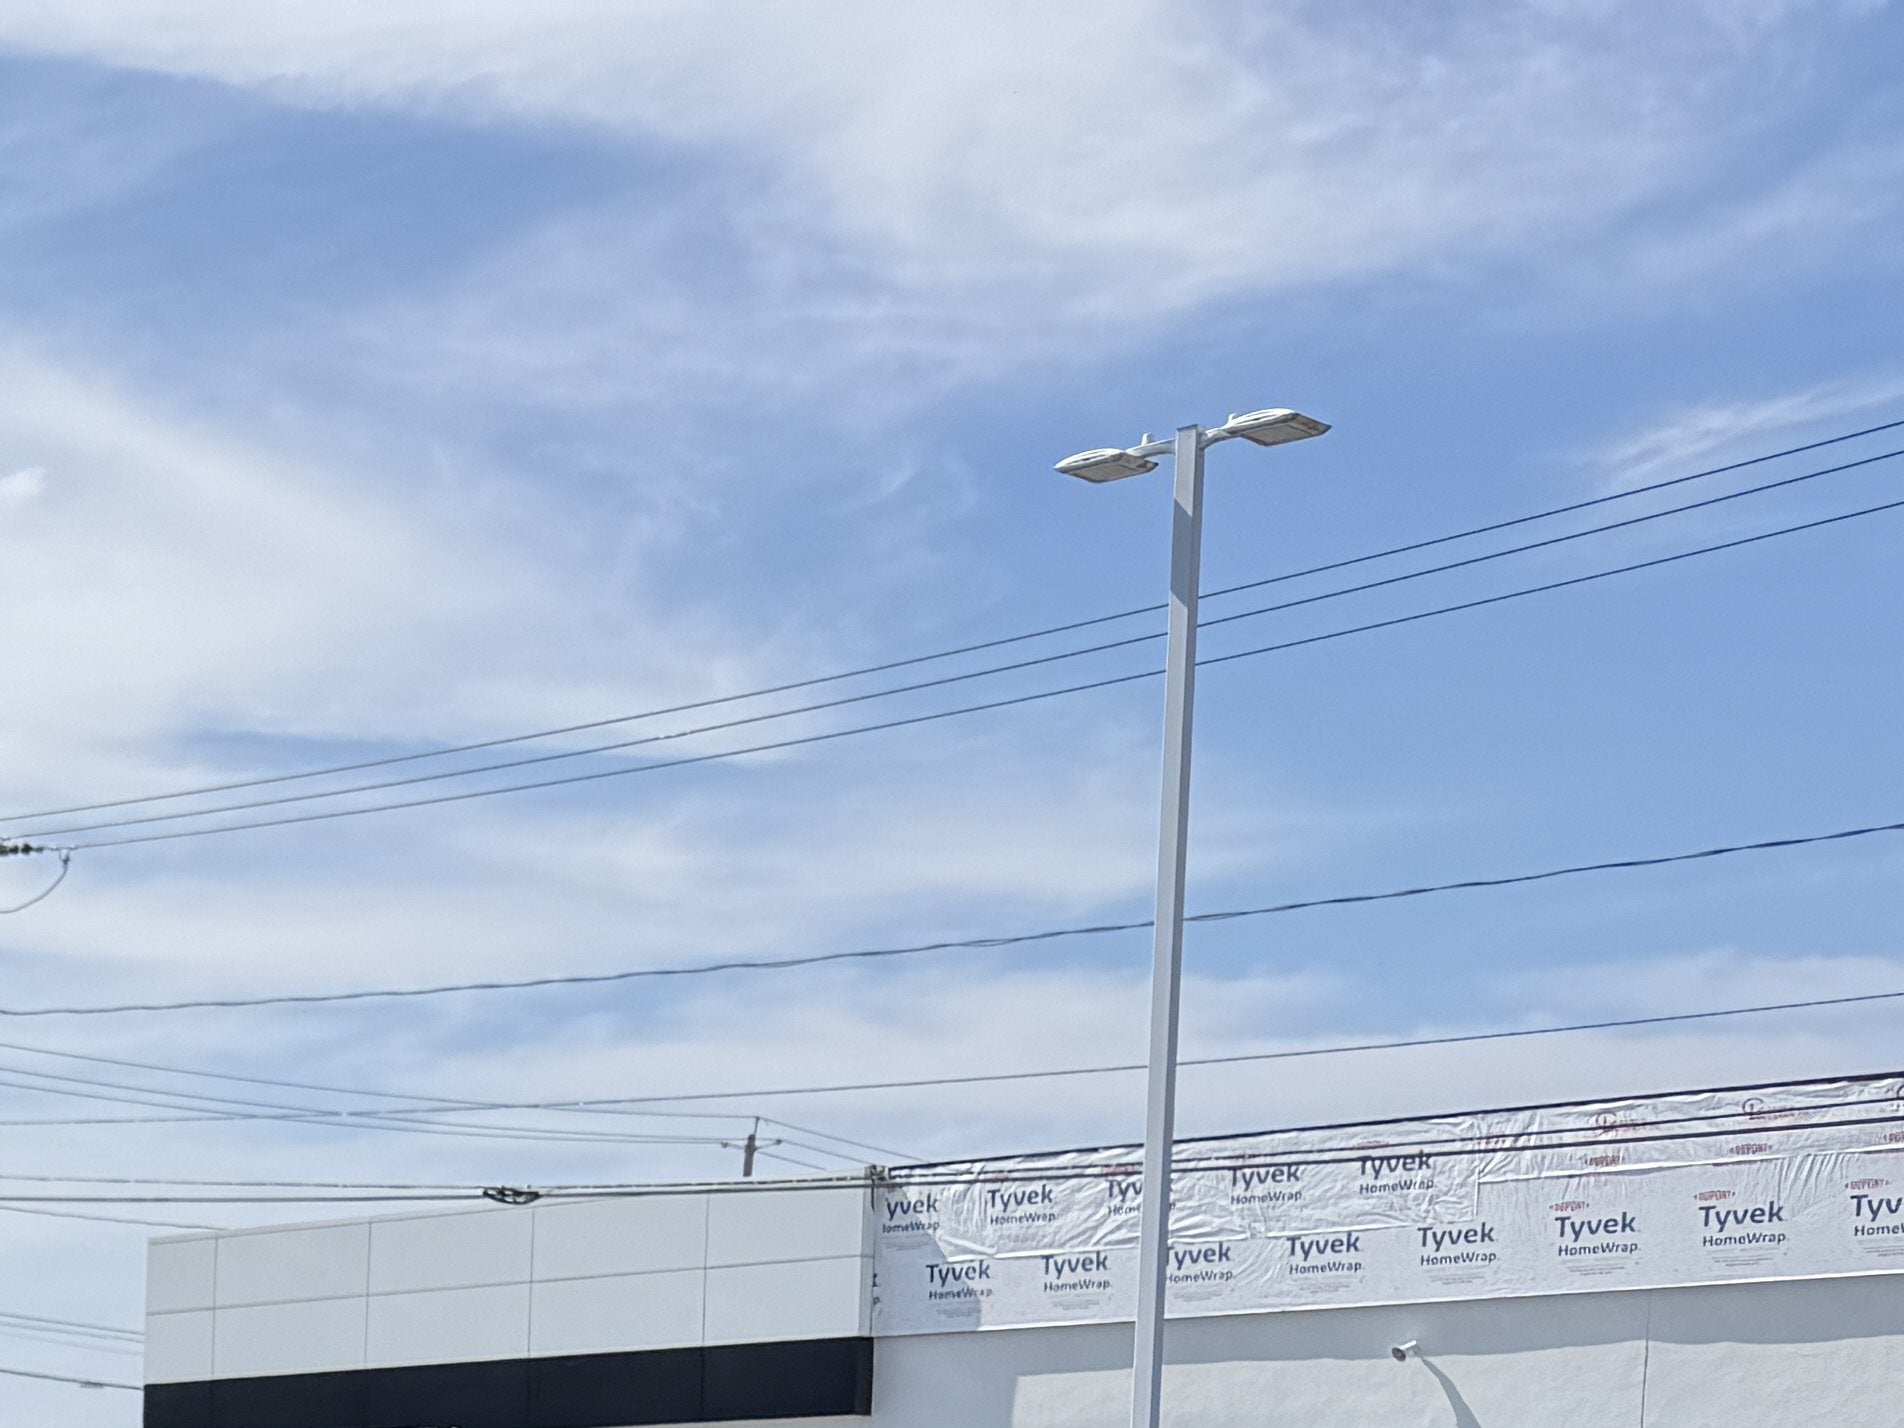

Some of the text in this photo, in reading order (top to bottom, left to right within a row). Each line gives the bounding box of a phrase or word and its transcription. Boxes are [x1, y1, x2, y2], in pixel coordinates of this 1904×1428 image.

[1228, 1163, 1302, 1191] Tyvek
[1357, 1150, 1433, 1181] Tyvek
[987, 1184, 1054, 1212] Tyvek
[1105, 1179, 1143, 1203] Tyv
[1359, 1178, 1435, 1195] HomeWrap
[885, 1193, 938, 1221] yvek
[1698, 1201, 1784, 1233] Tyvek
[1850, 1194, 1904, 1222] Tyv
[1417, 1222, 1495, 1252] Tyvek
[1554, 1212, 1636, 1242] Tyvek
[1702, 1232, 1786, 1247] HomeWrap
[1853, 1222, 1904, 1237] Home
[1287, 1232, 1360, 1261] Tyvek
[1420, 1250, 1497, 1266] HomeWrap
[1558, 1242, 1638, 1256] HomeWrap
[925, 1260, 991, 1287] Tyvek
[1042, 1250, 1108, 1279] Tyvek
[1289, 1260, 1362, 1275] HomeWrap
[929, 1287, 992, 1301] HomeWrap
[1044, 1279, 1110, 1293] HomeWrap
